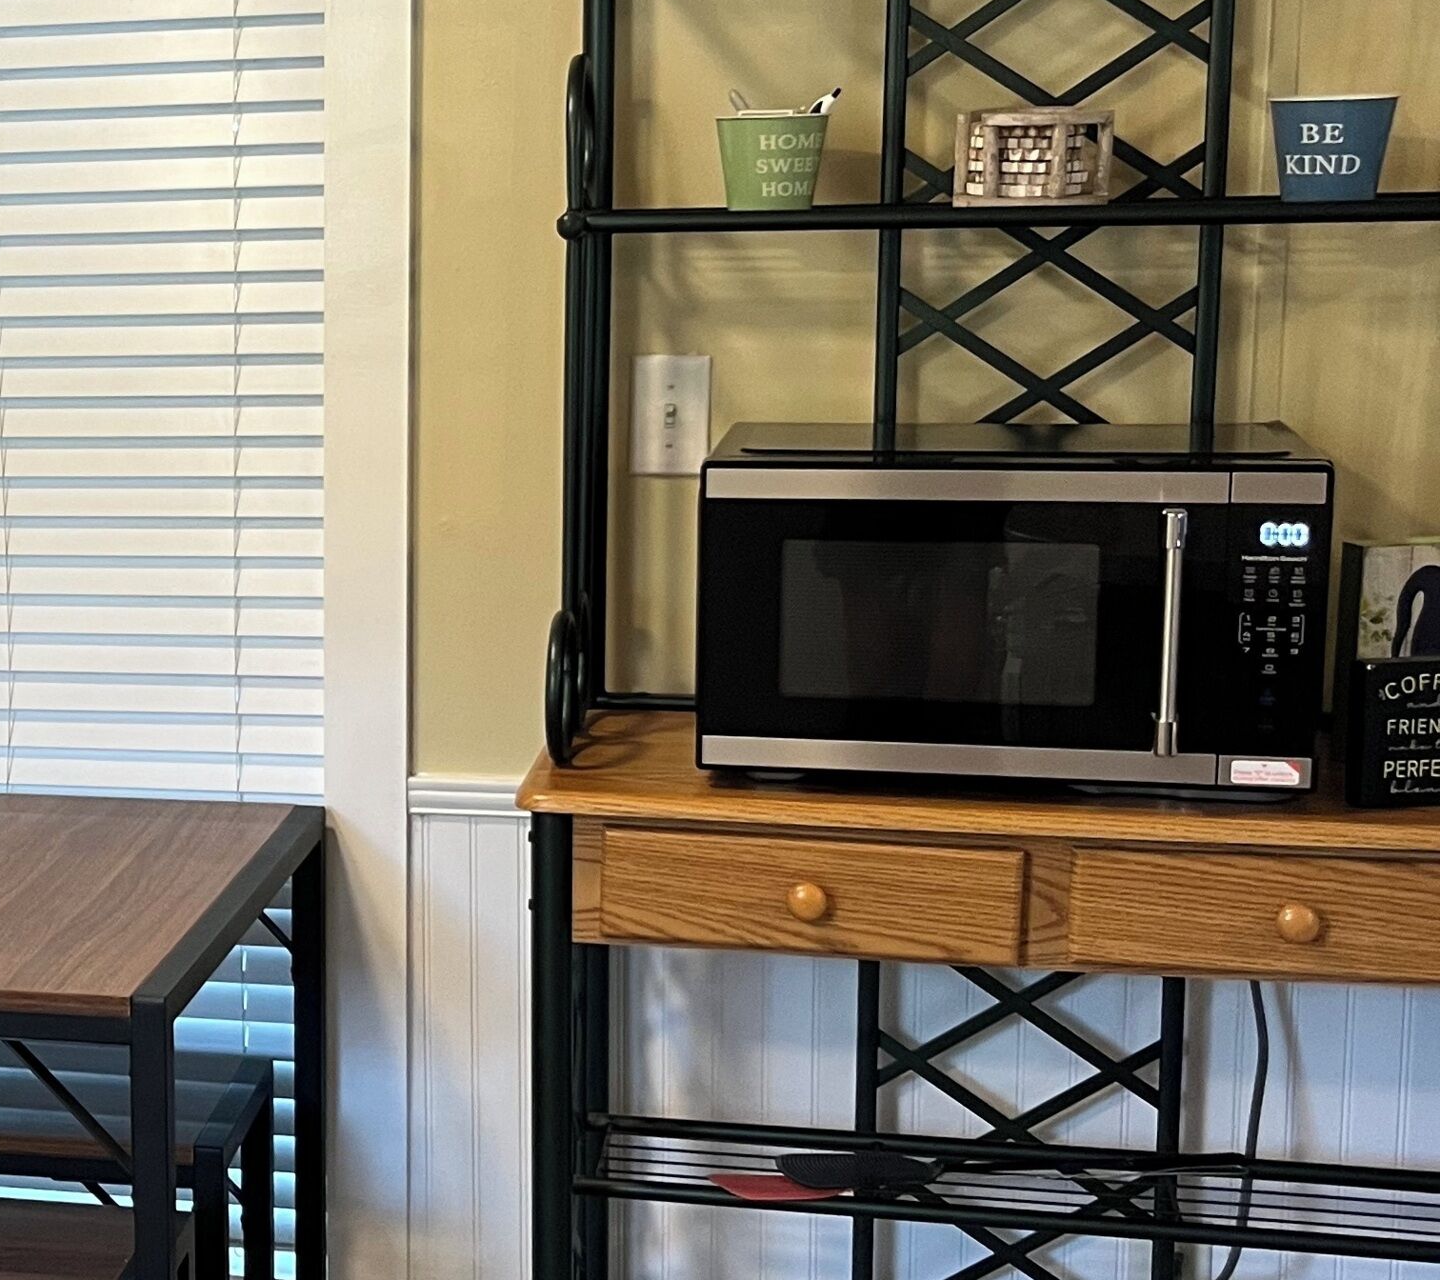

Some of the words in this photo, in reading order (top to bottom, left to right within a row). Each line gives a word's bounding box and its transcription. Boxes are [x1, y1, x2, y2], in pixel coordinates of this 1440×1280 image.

[1300, 123, 1344, 144] BE
[1284, 154, 1361, 175] KIND
[761, 180, 812, 197] HOM
[1383, 759, 1440, 778] PERFE
